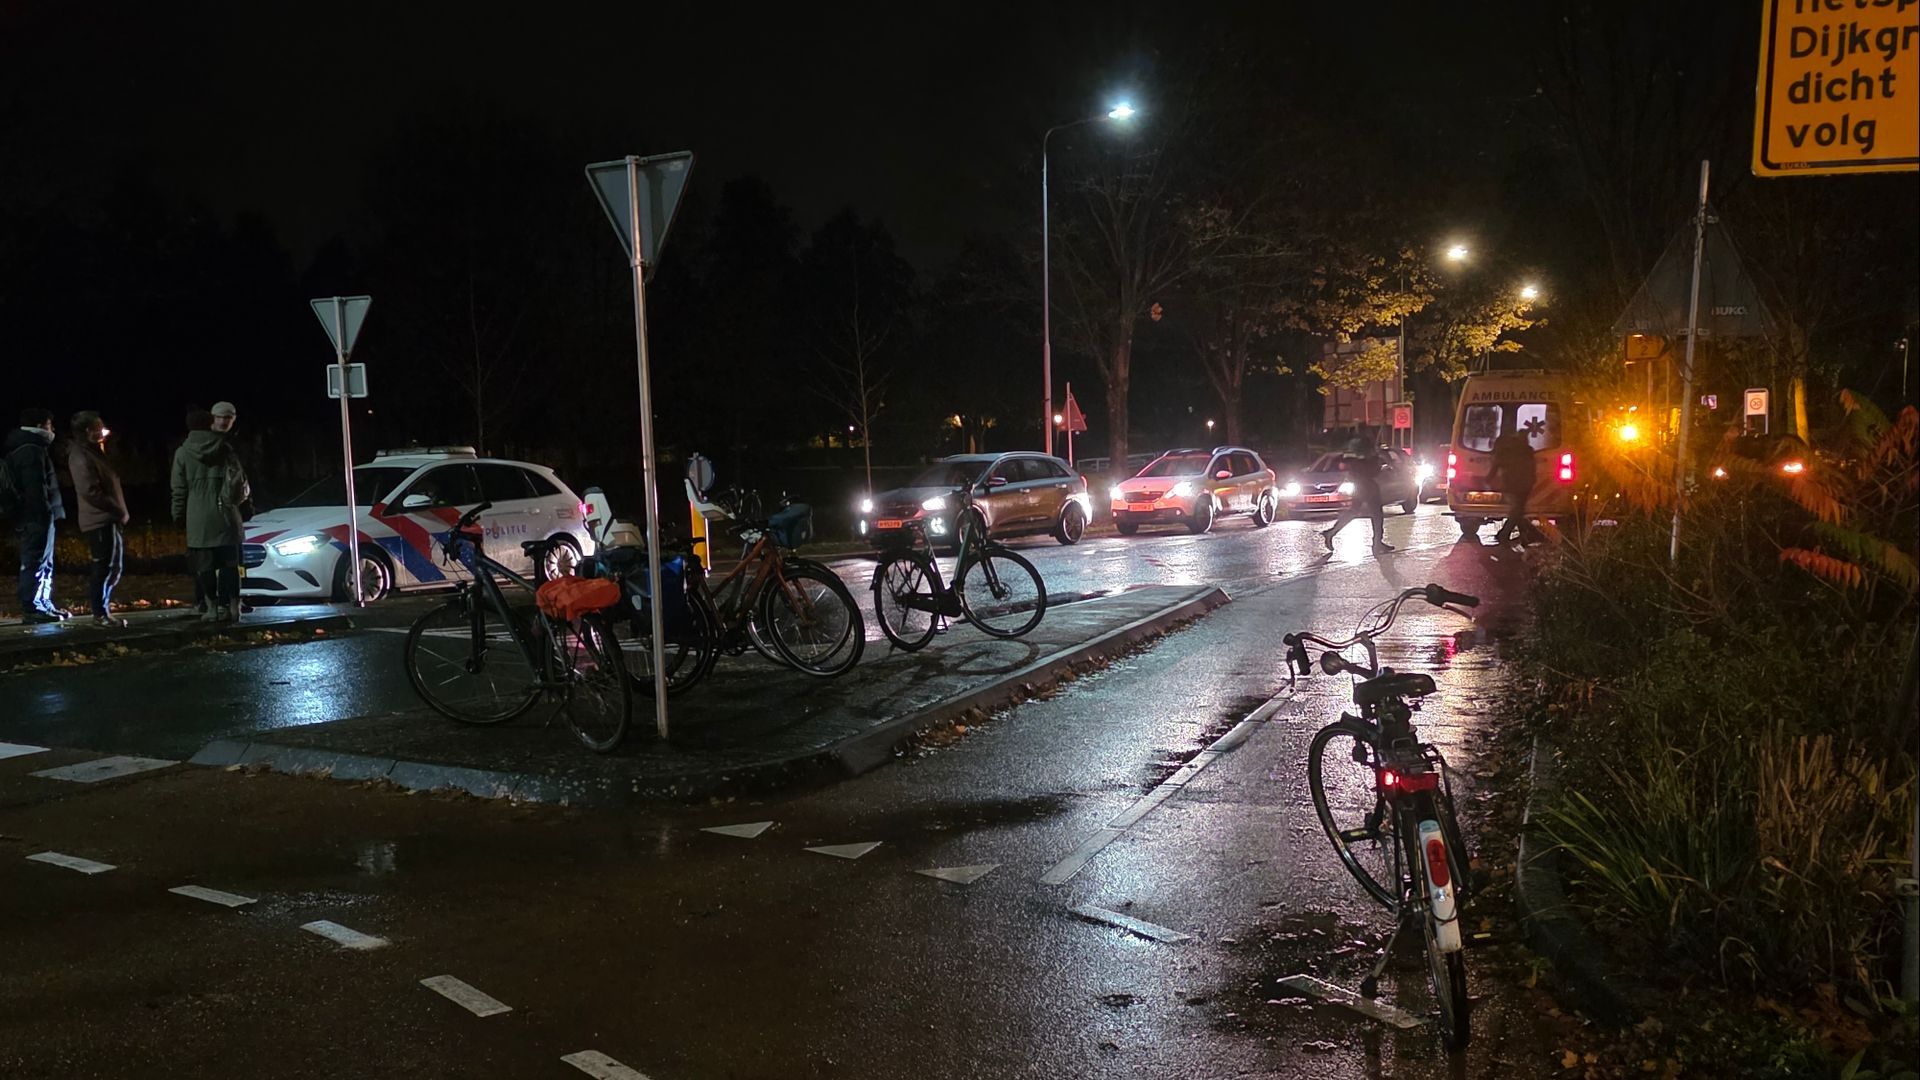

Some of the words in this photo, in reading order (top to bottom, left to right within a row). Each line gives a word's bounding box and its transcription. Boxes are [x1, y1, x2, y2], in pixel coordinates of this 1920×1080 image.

[1788, 67, 1897, 105] dicht
[1785, 113, 1877, 155] volg
[1472, 391, 1556, 401] AMBULANCE
